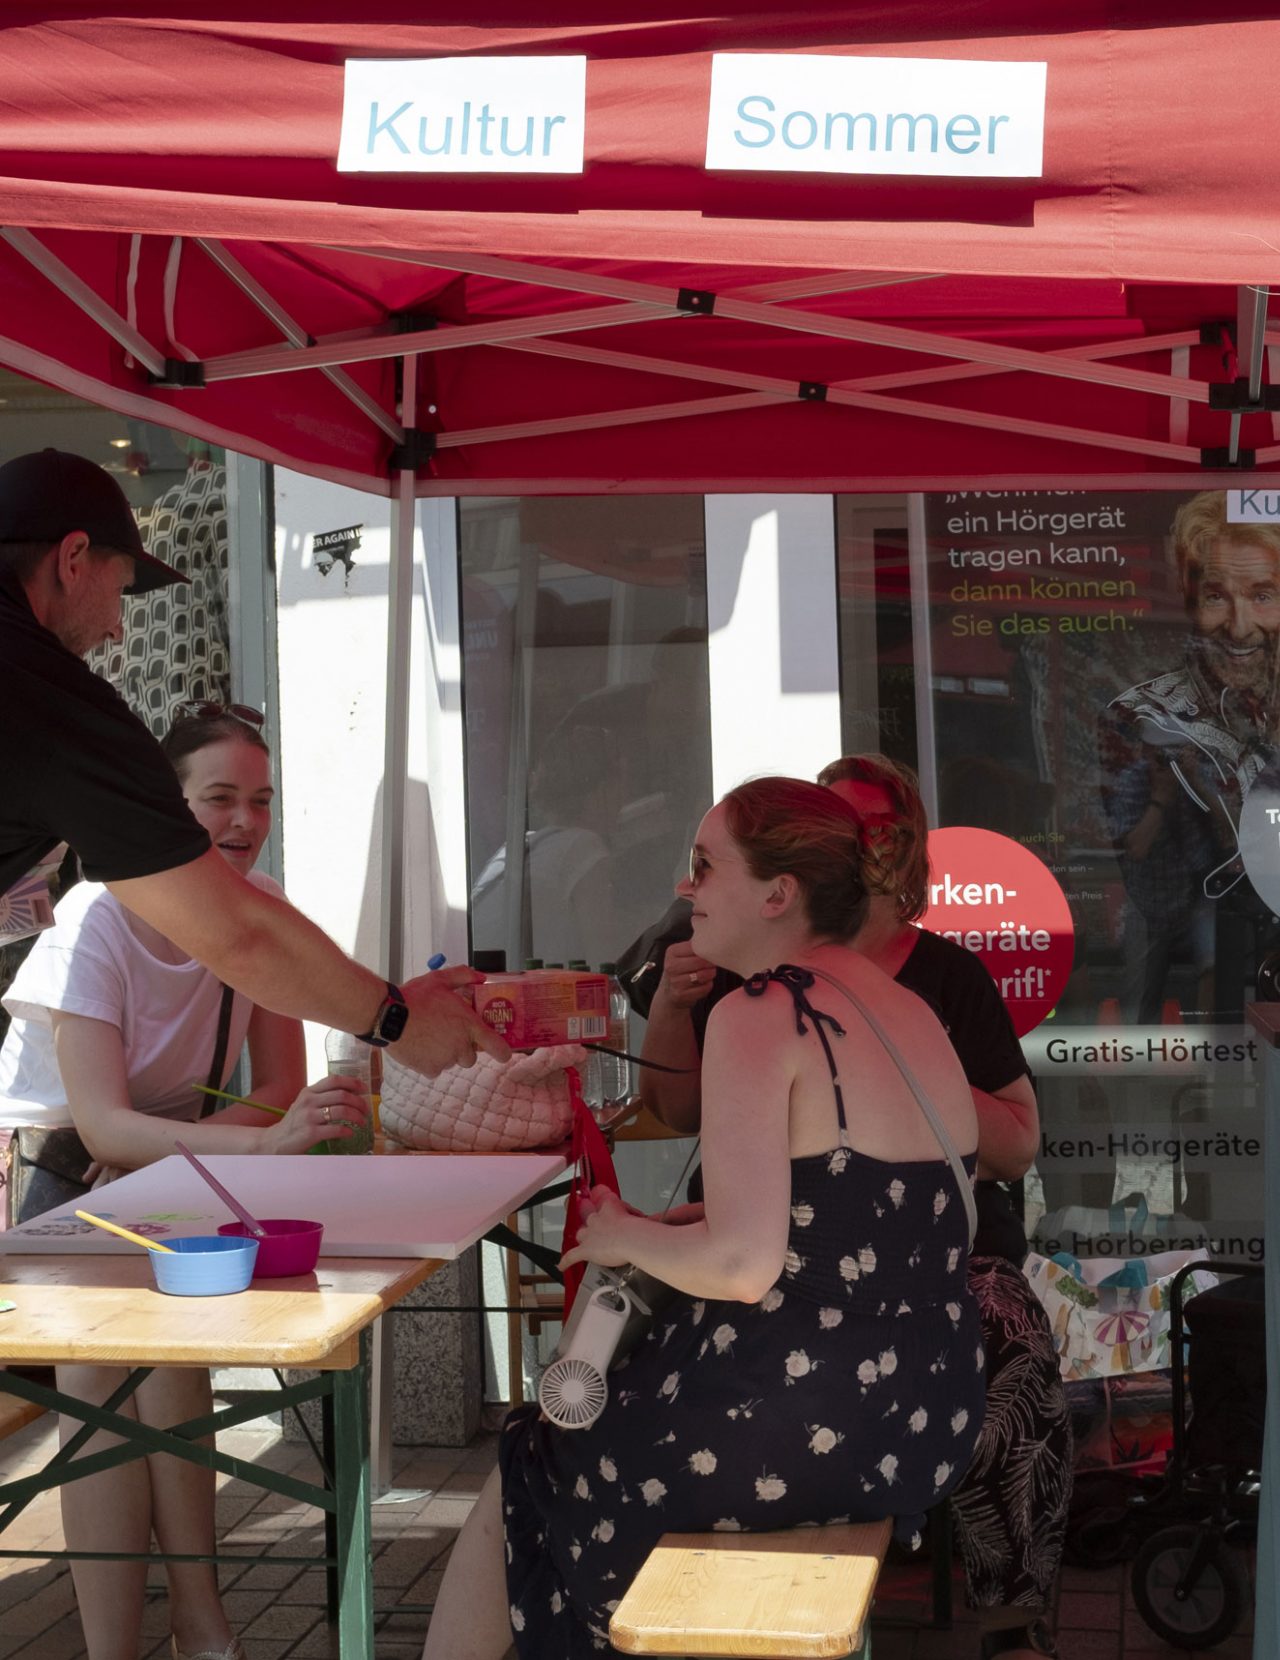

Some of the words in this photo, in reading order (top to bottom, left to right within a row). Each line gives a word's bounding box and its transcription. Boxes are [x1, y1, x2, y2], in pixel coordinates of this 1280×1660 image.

[367, 102, 566, 157] Kultur
[734, 96, 1009, 154] Sommer
[947, 513, 989, 534] ein
[997, 507, 1127, 536] Hörgerät
[948, 547, 1042, 572] tragen
[1050, 543, 1126, 567] kann,
[951, 580, 1021, 602] dann
[1031, 577, 1136, 599] können
[952, 614, 993, 637] Sie
[1000, 612, 1050, 636] das
[931, 873, 1018, 906] rken-
[1046, 1038, 1258, 1063] Gratis-Hörtest
[1042, 1132, 1261, 1163] ken-Hörgeräte
[1072, 1230, 1265, 1264] Hörberatung
